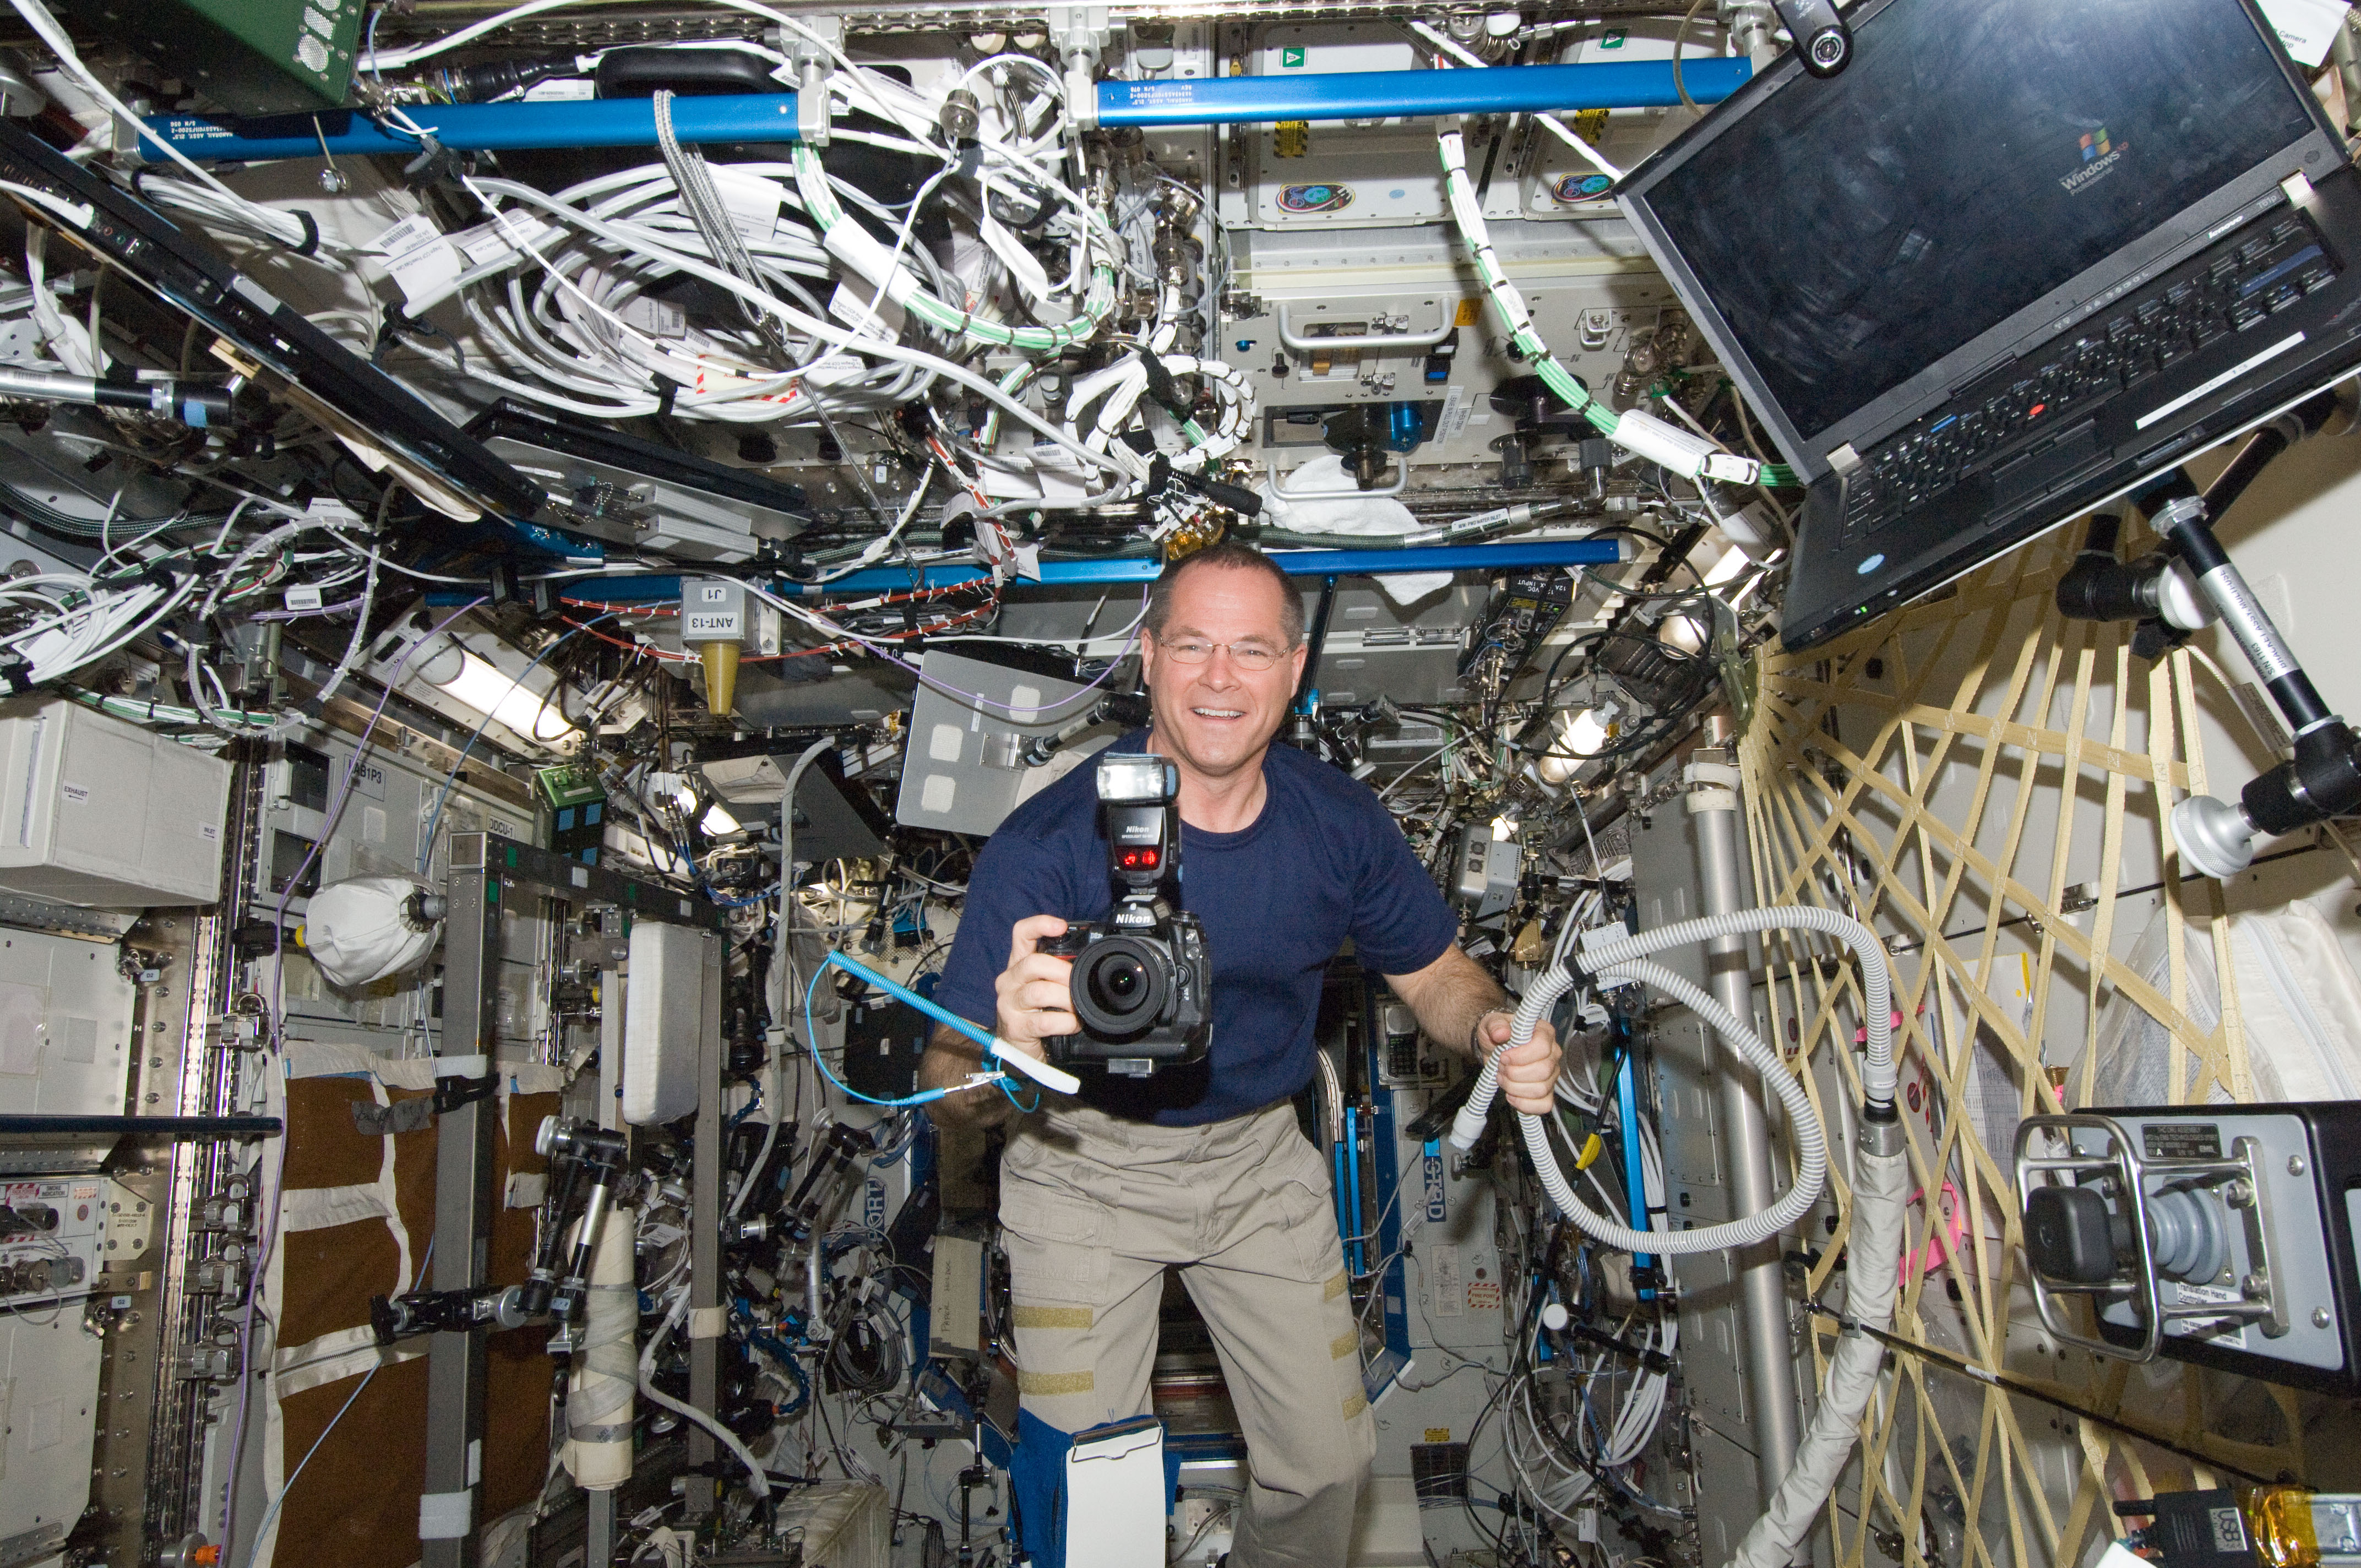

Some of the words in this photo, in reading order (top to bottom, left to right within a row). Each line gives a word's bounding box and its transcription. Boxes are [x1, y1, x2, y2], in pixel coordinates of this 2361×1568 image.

[2279, 30, 2307, 43] Camera
[2061, 150, 2121, 190] Windows
[2070, 166, 2114, 197] Professional
[2257, 195, 2277, 209] T61p
[2208, 215, 2244, 239] lenovo
[2187, 363, 2248, 400] SSC-13
[708, 589, 722, 600] J1
[692, 617, 734, 629] ANT-13
[2250, 642, 2267, 661] 1163
[2262, 660, 2276, 676] S/N
[349, 759, 382, 785] LAB1P3
[64, 785, 88, 797] EXHAUST
[204, 826, 216, 835] INLET
[1116, 914, 1151, 924] Nikon
[2156, 1148, 2163, 1156] A
[866, 1183, 884, 1243] PORT
[2210, 1289, 2227, 1300] Hand
[2217, 1509, 2242, 1542] USB
